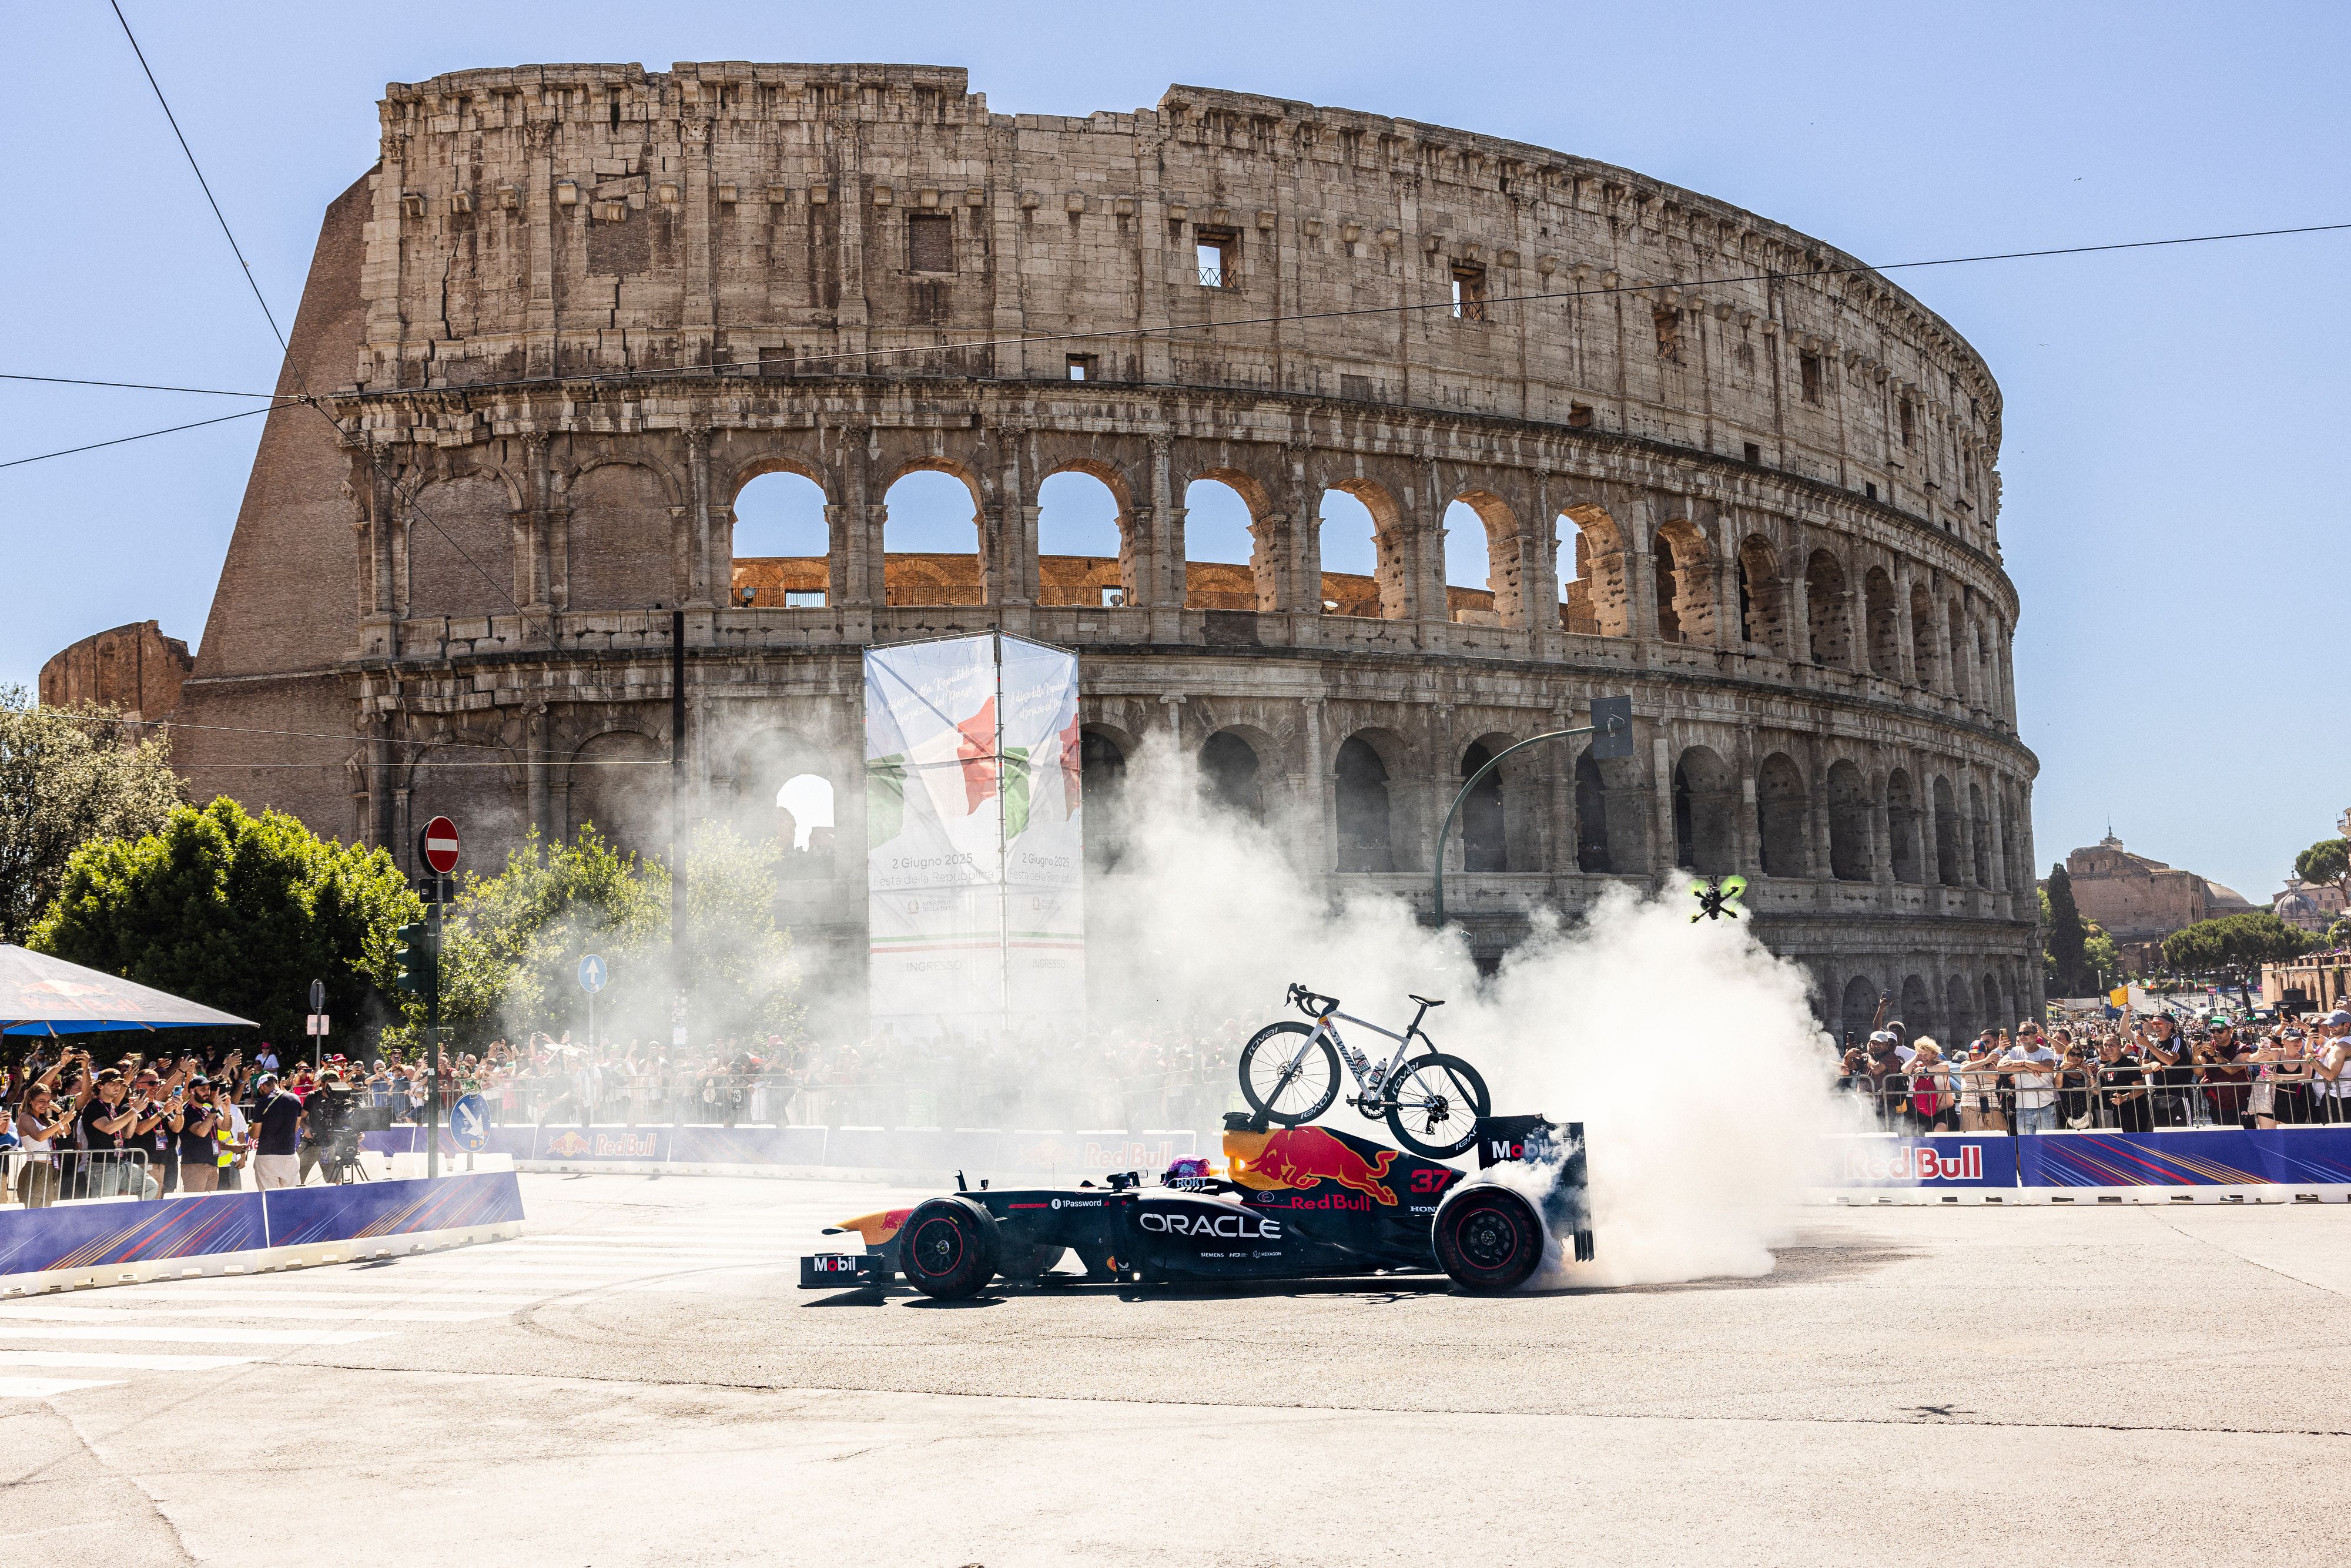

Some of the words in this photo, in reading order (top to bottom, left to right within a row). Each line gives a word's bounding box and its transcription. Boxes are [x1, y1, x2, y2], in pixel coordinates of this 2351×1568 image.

[892, 859, 898, 869] 2
[902, 857, 942, 870] Giugno
[945, 853, 973, 865] 2025
[1022, 853, 1027, 863] 2
[1028, 853, 1053, 868] Giugno
[1054, 856, 1070, 868] 2025
[873, 876, 901, 886] Festa
[904, 873, 929, 885] della
[932, 869, 994, 884] Repubblica
[1009, 868, 1029, 880] Festa
[1030, 870, 1046, 882] della
[906, 960, 962, 972] INGRESSO
[1032, 959, 1066, 969] INGRESSO
[595, 1133, 627, 1156] Red
[626, 1133, 657, 1156] Bull
[1492, 1139, 1549, 1158] Mobil
[1086, 1142, 1128, 1168] Red
[1130, 1142, 1172, 1169] Bull
[1846, 1147, 1911, 1179] Red
[1915, 1145, 1982, 1180] Bull
[1177, 1178, 1207, 1187] ROKT
[1411, 1170, 1452, 1193] 37
[1291, 1194, 1329, 1209] Red
[1333, 1194, 1370, 1211] Bull
[1140, 1213, 1282, 1239] ORACLE
[814, 1257, 856, 1272] Mobil
